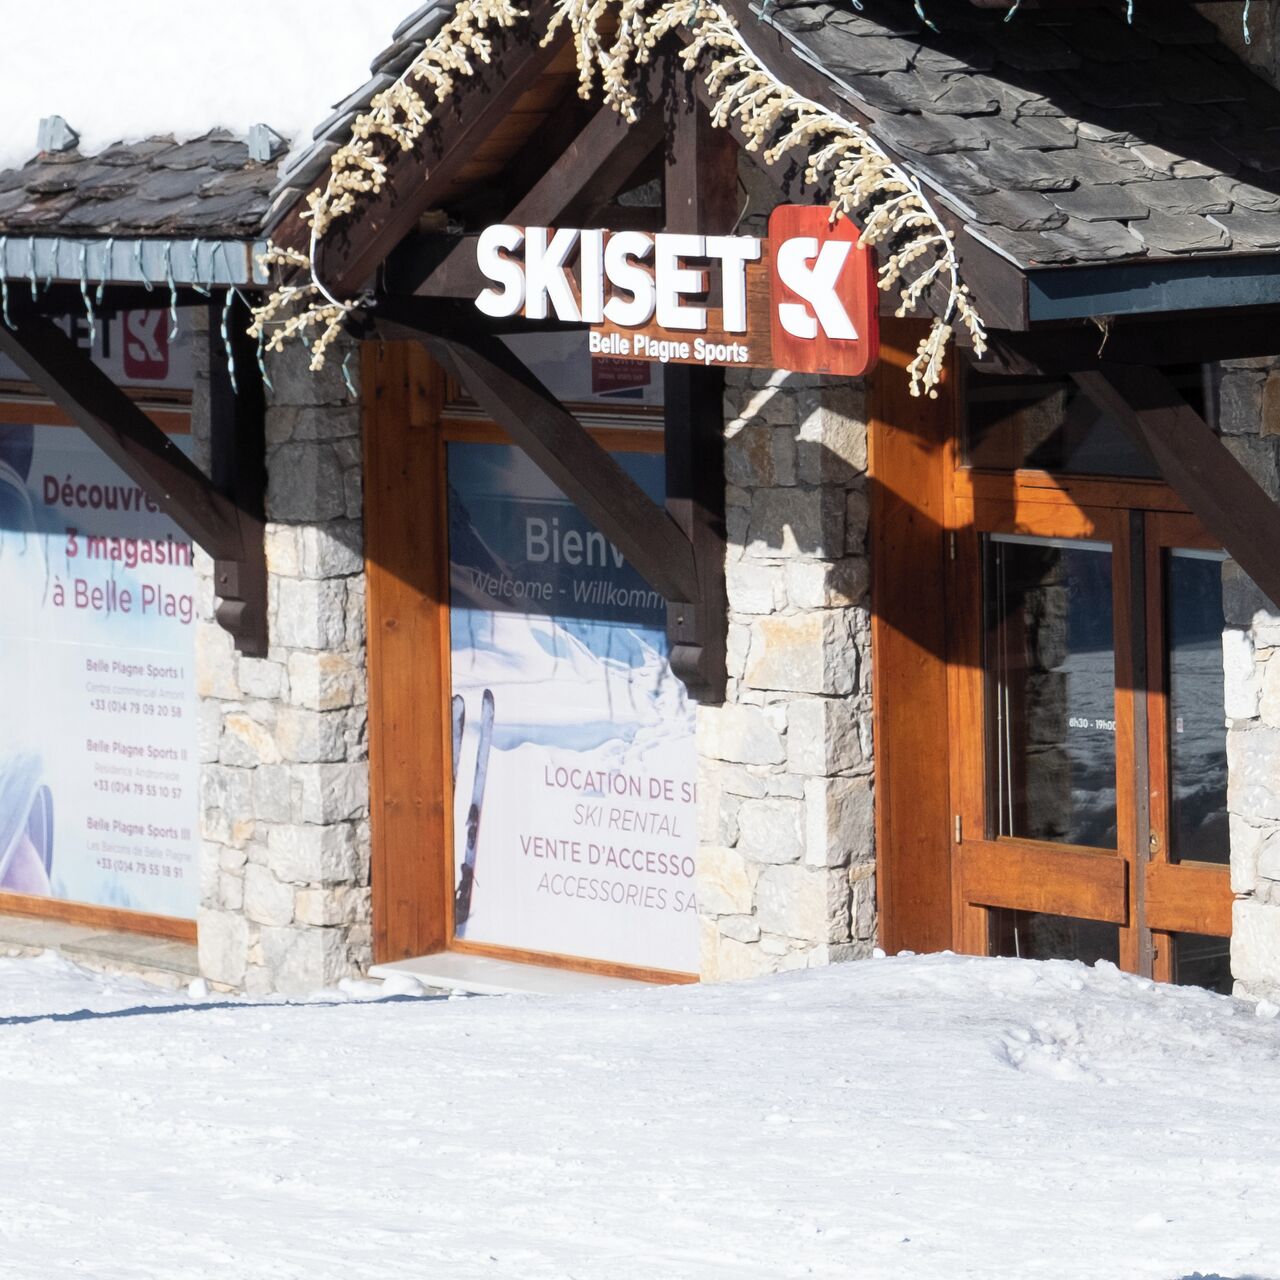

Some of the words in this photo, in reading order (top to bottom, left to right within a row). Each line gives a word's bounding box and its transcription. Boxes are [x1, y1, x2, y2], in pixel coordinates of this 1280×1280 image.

[474, 224, 761, 332] SKISET
[589, 331, 630, 355] Belle
[633, 334, 689, 363] Plagne
[694, 338, 748, 366] Sports
[65, 527, 78, 558] 3
[53, 575, 65, 608] à
[75, 578, 132, 613] Belle
[470, 570, 553, 600] Welcome
[86, 658, 109, 672] Belle
[112, 660, 144, 677] Plagne
[147, 664, 178, 679] Sports
[90, 698, 106, 711] +33
[107, 700, 127, 713] (0)4
[130, 702, 140, 714] 79
[86, 738, 110, 753] Belle
[112, 741, 144, 758] Plagne
[147, 745, 178, 760] Sports
[93, 779, 109, 792] +33
[111, 781, 130, 794] (0)4
[133, 783, 144, 795] 79
[544, 764, 642, 798] LOCATION
[649, 777, 674, 801] DE
[87, 817, 109, 831] Belle
[112, 819, 145, 836] Plagne
[147, 823, 178, 839] Sports
[573, 803, 603, 827] SKI
[608, 807, 682, 838] RENTAL
[520, 834, 582, 863] VENTE
[96, 857, 112, 870] +33
[113, 859, 133, 873] (0)4
[136, 861, 146, 874] 79
[536, 871, 668, 910] ACCESSORIES
